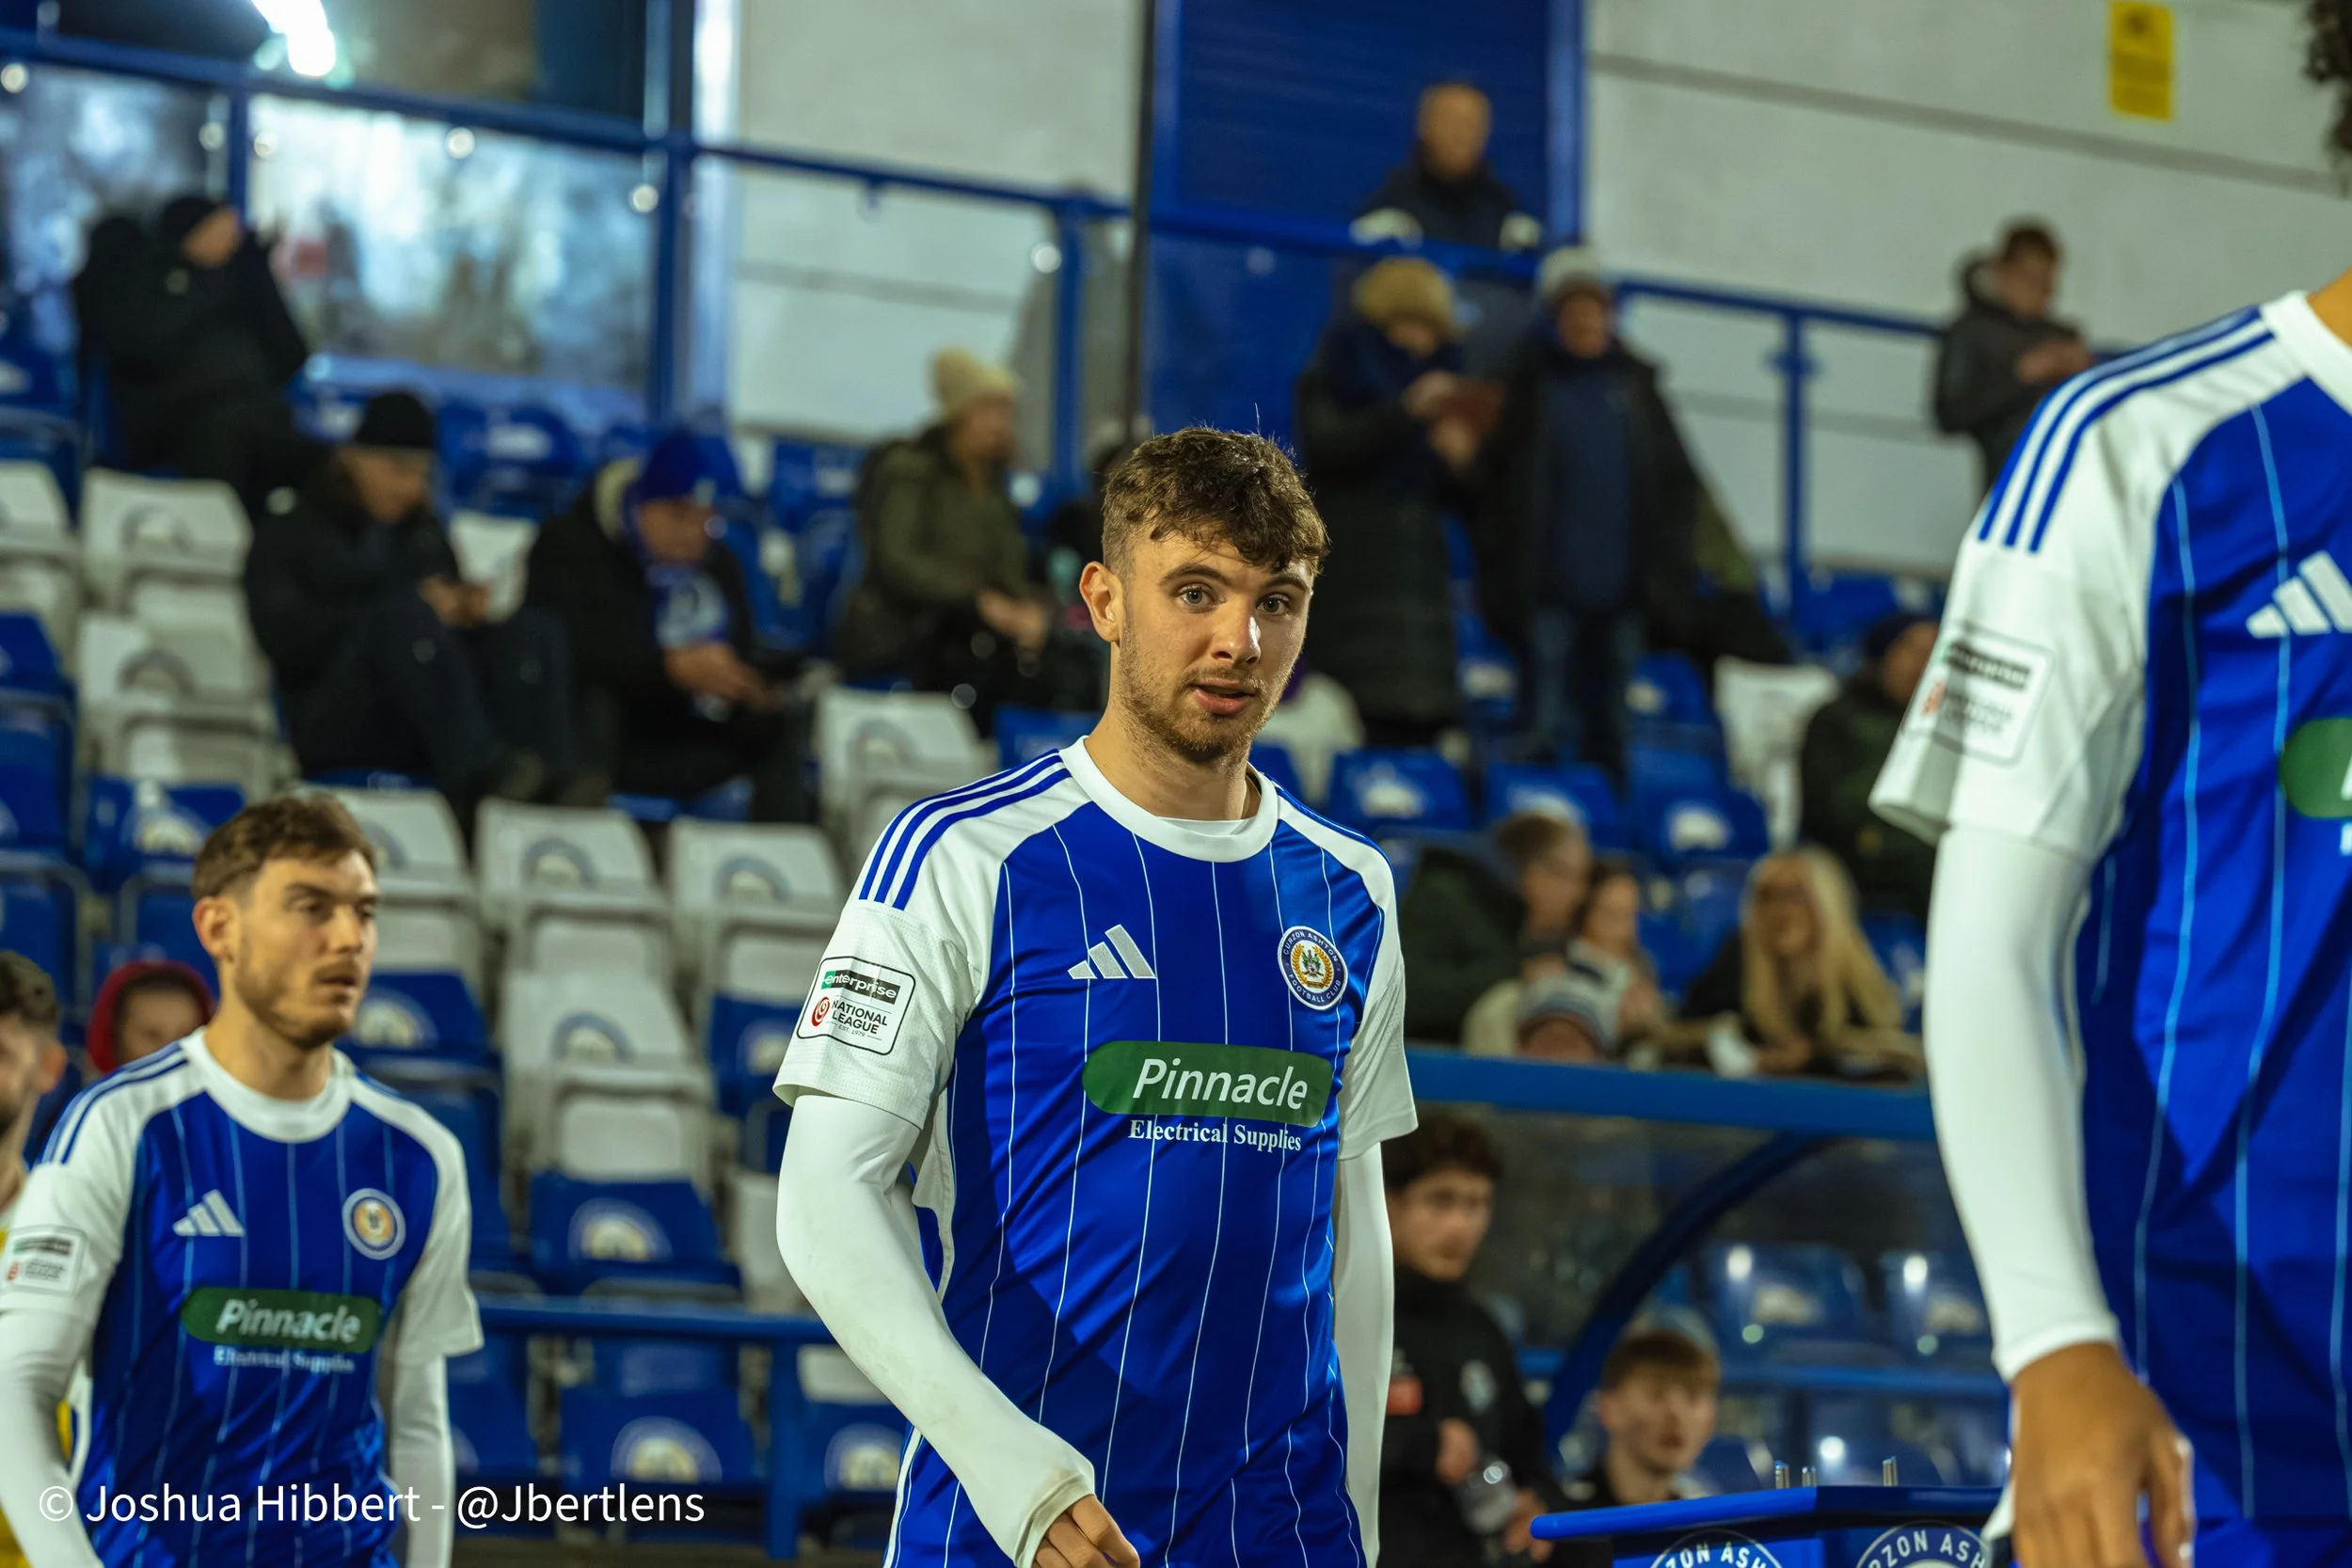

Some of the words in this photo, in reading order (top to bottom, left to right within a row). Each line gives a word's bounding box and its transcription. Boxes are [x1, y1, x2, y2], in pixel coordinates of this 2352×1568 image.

[1282, 930, 1306, 956] CURZON
[1308, 933, 1339, 961] ASHTON
[823, 973, 897, 999] enterprise
[1288, 974, 1326, 1003] FOOTBALL
[1326, 979, 1342, 1000] CLUB
[832, 1000, 887, 1026] NATIONAL
[832, 1010, 879, 1034] LEAGUE
[1133, 1058, 1308, 1110] Pinnacle
[1128, 1119, 1228, 1143] Electrical
[1233, 1124, 1301, 1152] Supplies
[215, 1298, 361, 1344] Pinnacle
